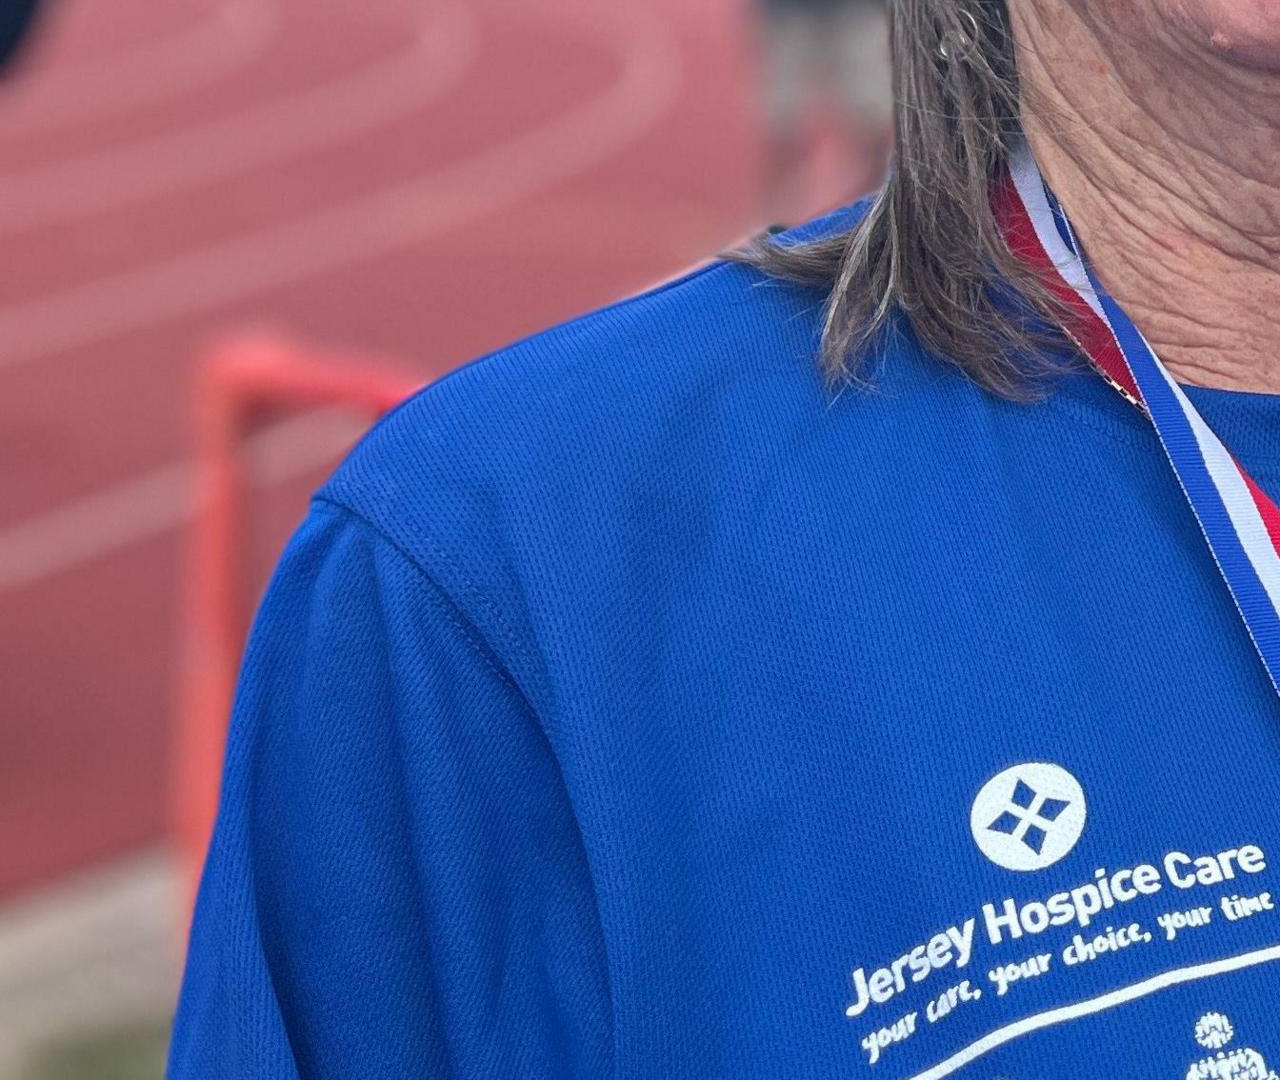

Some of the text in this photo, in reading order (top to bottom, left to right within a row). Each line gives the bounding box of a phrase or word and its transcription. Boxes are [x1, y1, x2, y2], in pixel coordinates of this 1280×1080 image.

[846, 844, 1266, 1017] Jersey Hospice Care
[861, 892, 1274, 1065] your care, your choice, your time
